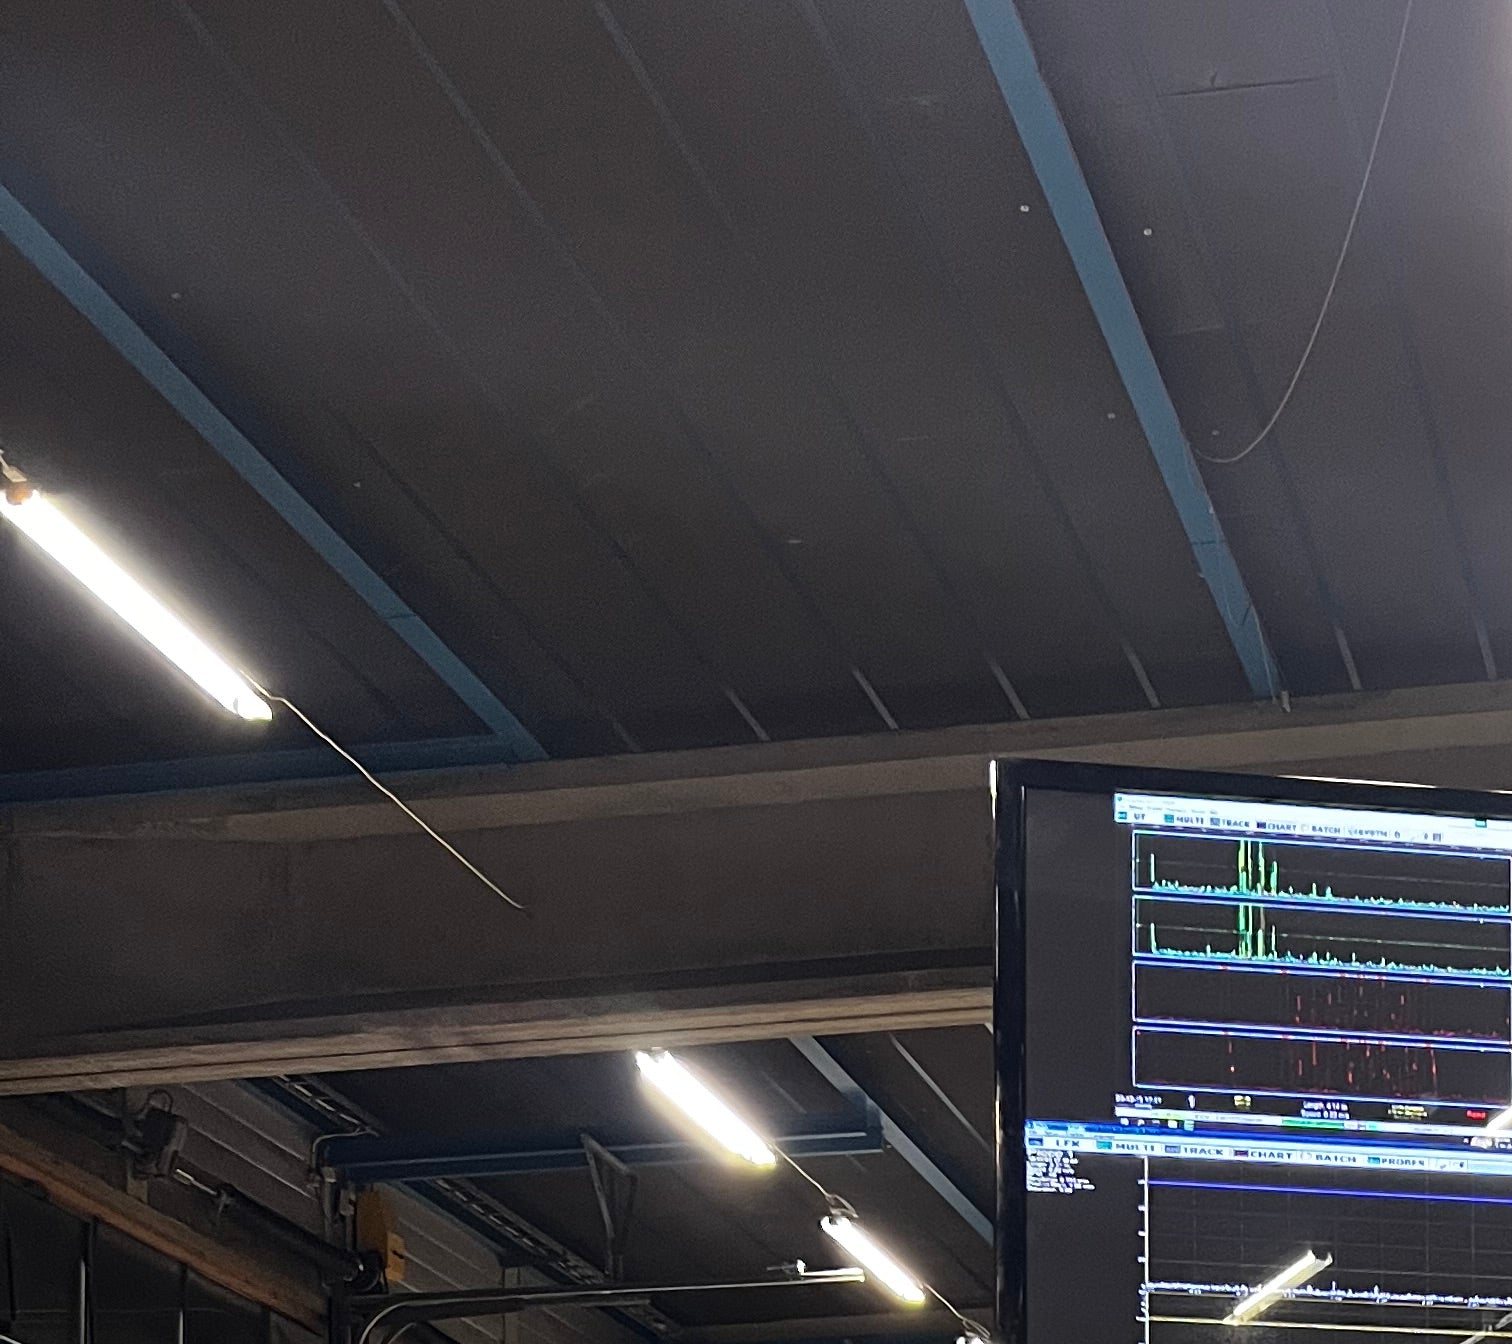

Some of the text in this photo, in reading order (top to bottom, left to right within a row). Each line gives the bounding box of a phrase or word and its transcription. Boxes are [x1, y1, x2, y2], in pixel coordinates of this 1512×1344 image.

[1176, 815, 1205, 824] MULTI
[1221, 819, 1250, 828] TRACK
[1268, 822, 1297, 832] CHART
[1312, 825, 1341, 834] BATCH
[1184, 1147, 1223, 1156] TRACK
[1250, 1151, 1293, 1159] CHART
[1315, 1154, 1356, 1163] BATCH
